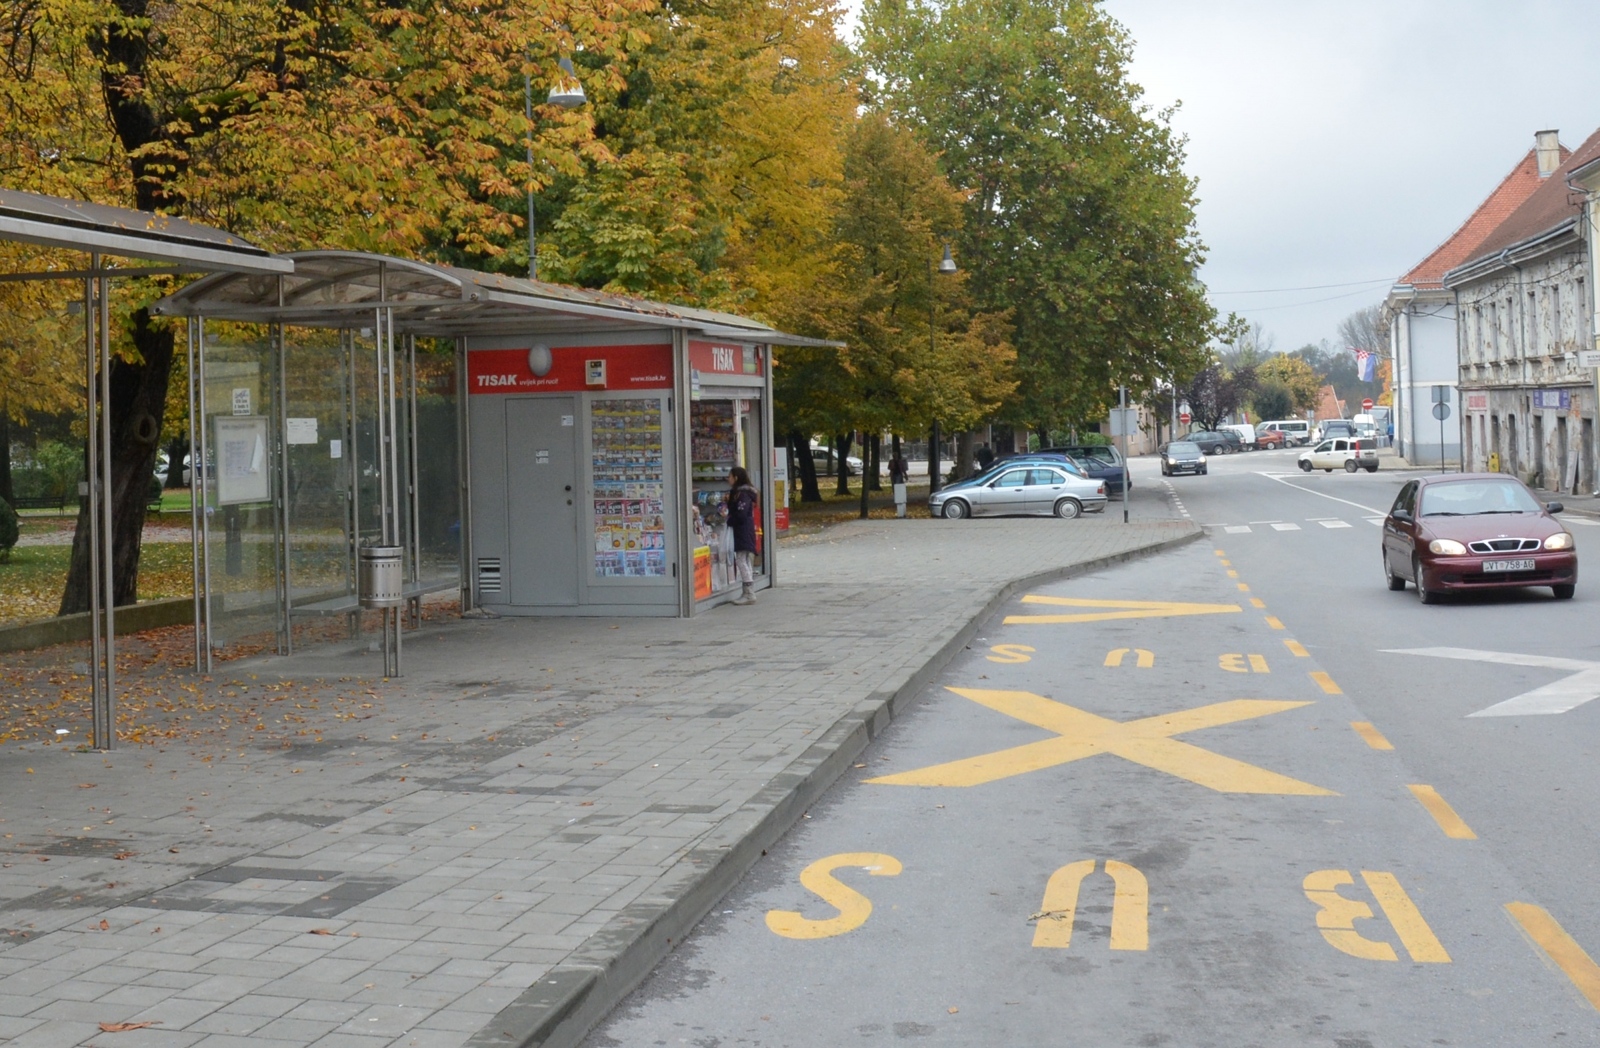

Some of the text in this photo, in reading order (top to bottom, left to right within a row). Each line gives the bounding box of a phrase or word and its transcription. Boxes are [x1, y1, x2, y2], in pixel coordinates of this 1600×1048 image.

[711, 347, 735, 372] TISAK
[477, 374, 518, 387] TISAK
[519, 378, 537, 387] uvijek
[536, 378, 545, 386] pri
[1488, 560, 1534, 570] VT 758-AG
[765, 852, 1451, 964] BUS
